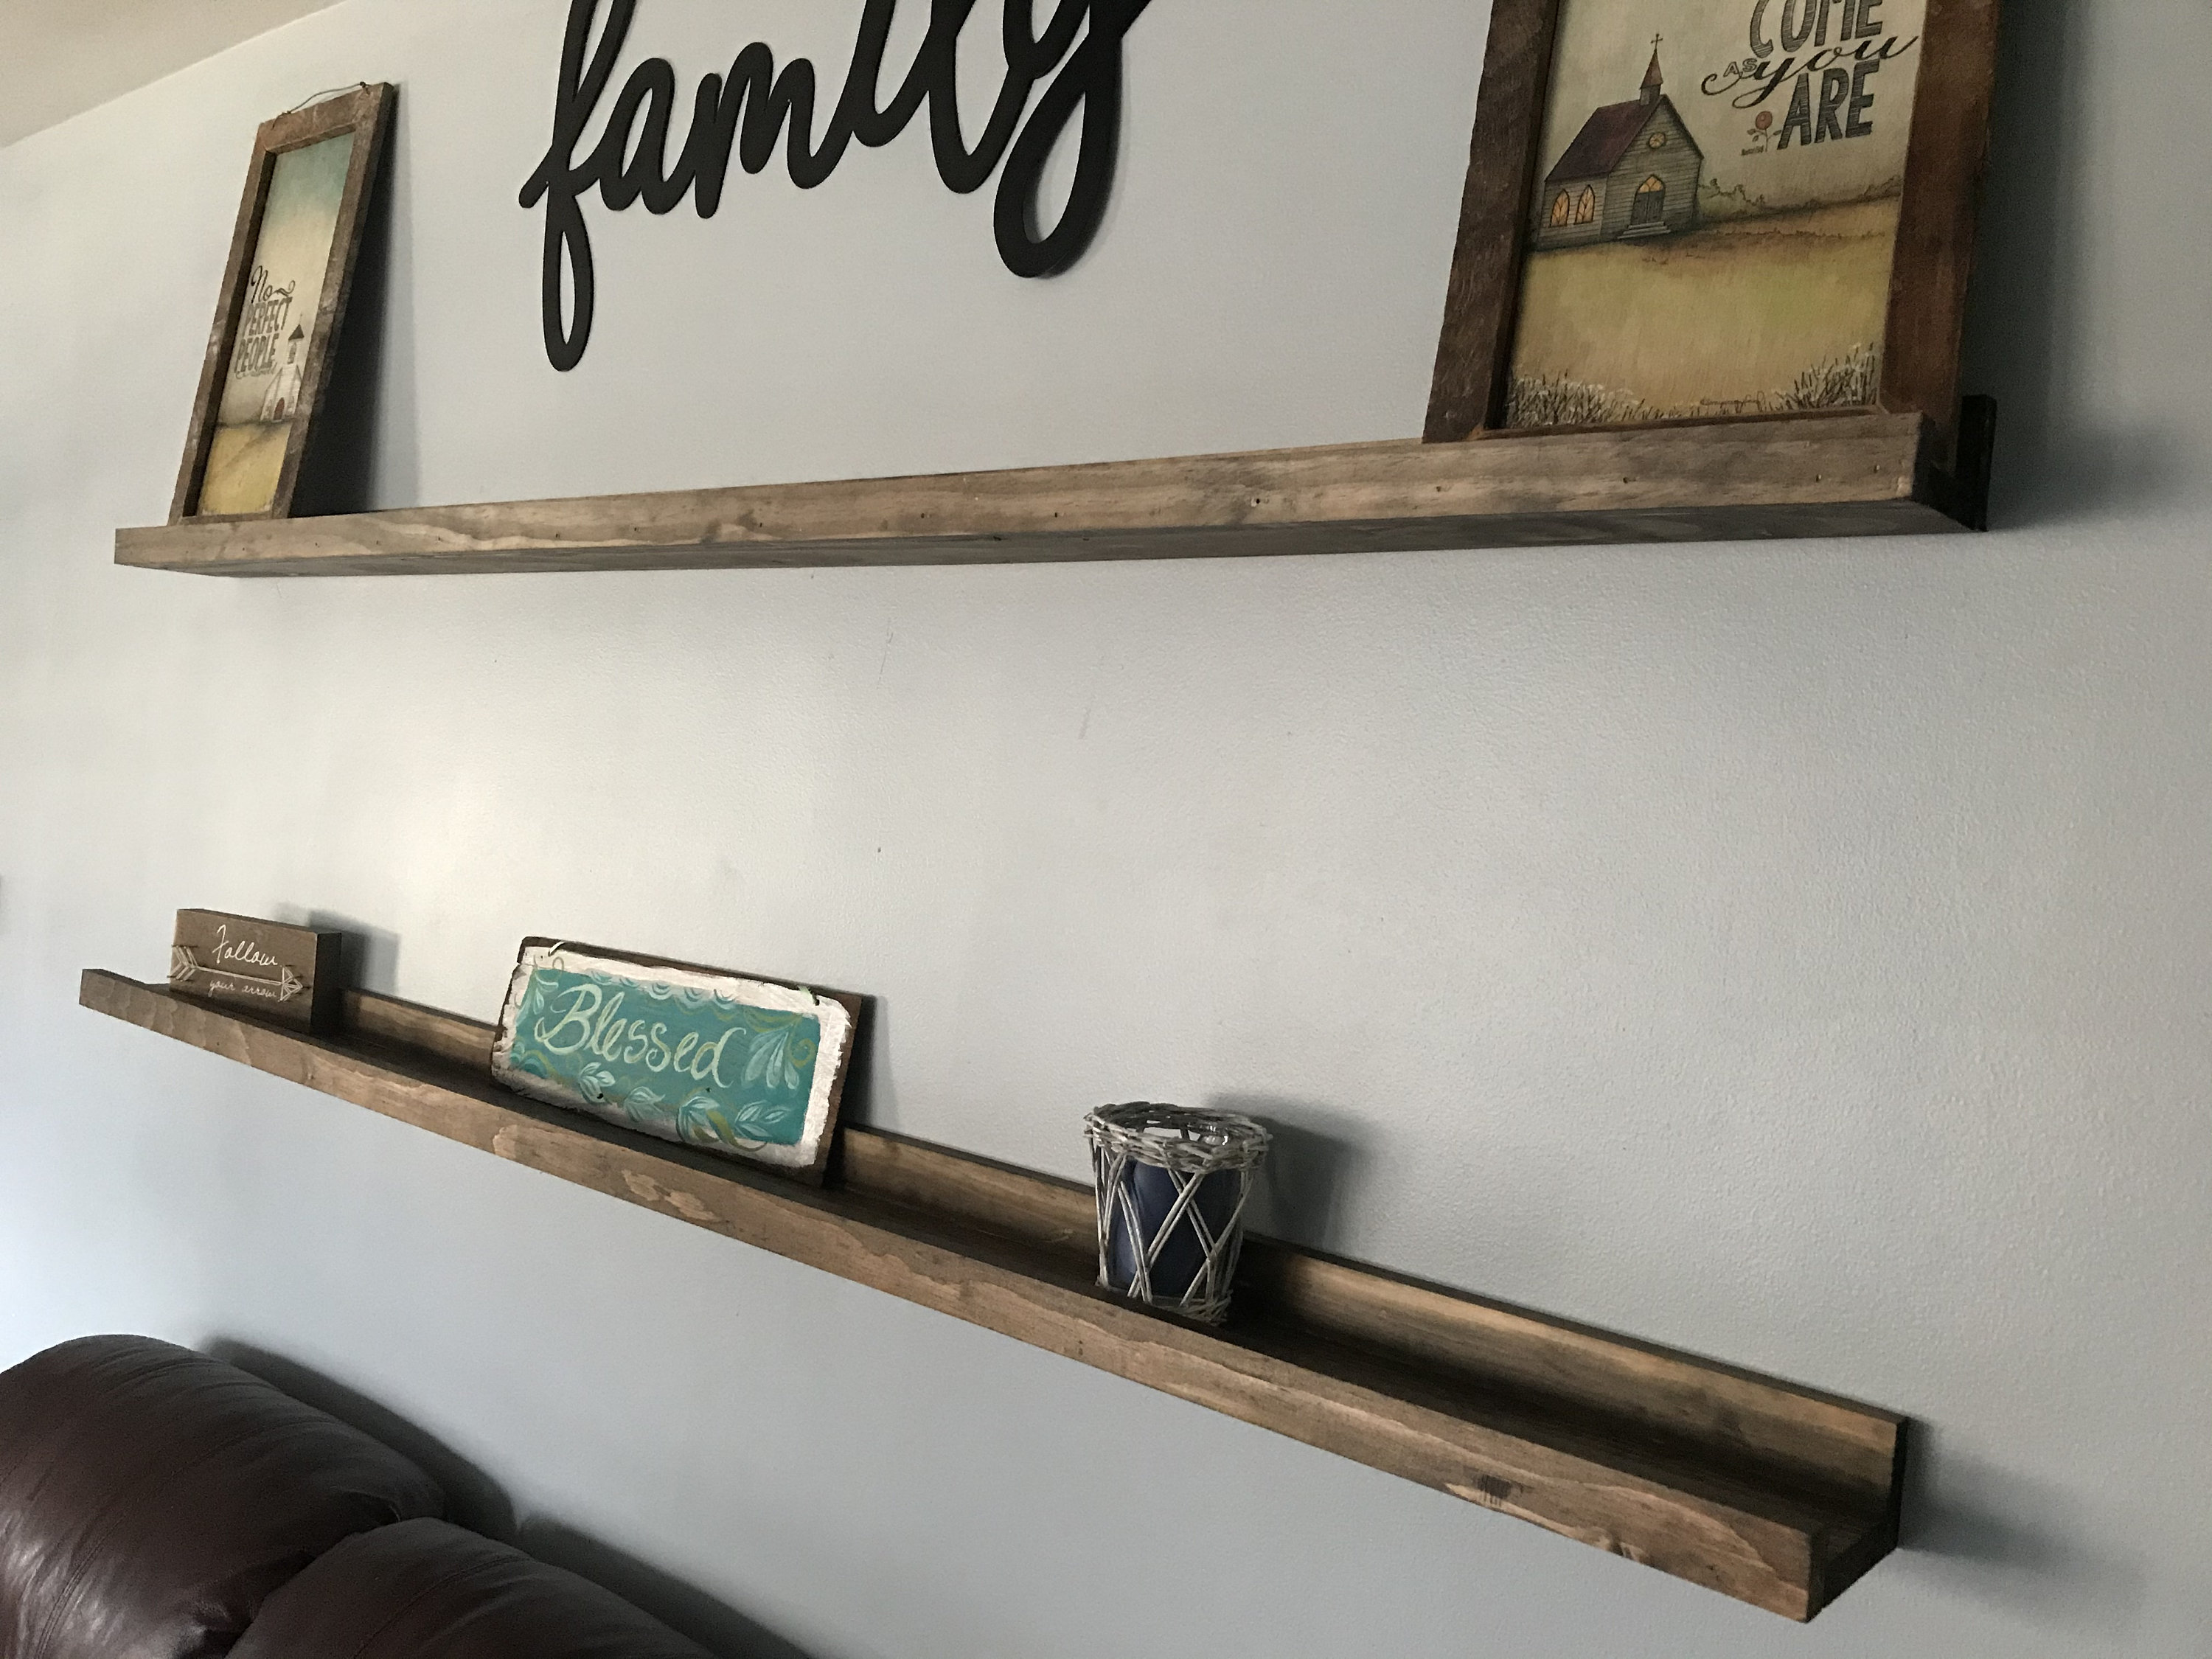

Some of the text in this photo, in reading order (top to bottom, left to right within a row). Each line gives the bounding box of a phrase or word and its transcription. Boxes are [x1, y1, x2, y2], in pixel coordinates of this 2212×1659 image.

[1701, 35, 1919, 108] AS you
[1777, 59, 1879, 150] ARE
[243, 296, 293, 338] PERFECT
[234, 333, 279, 373] PEOPLE
[212, 925, 278, 965] Follow
[208, 979, 276, 998] your arrow
[535, 984, 747, 1088] Blessed
